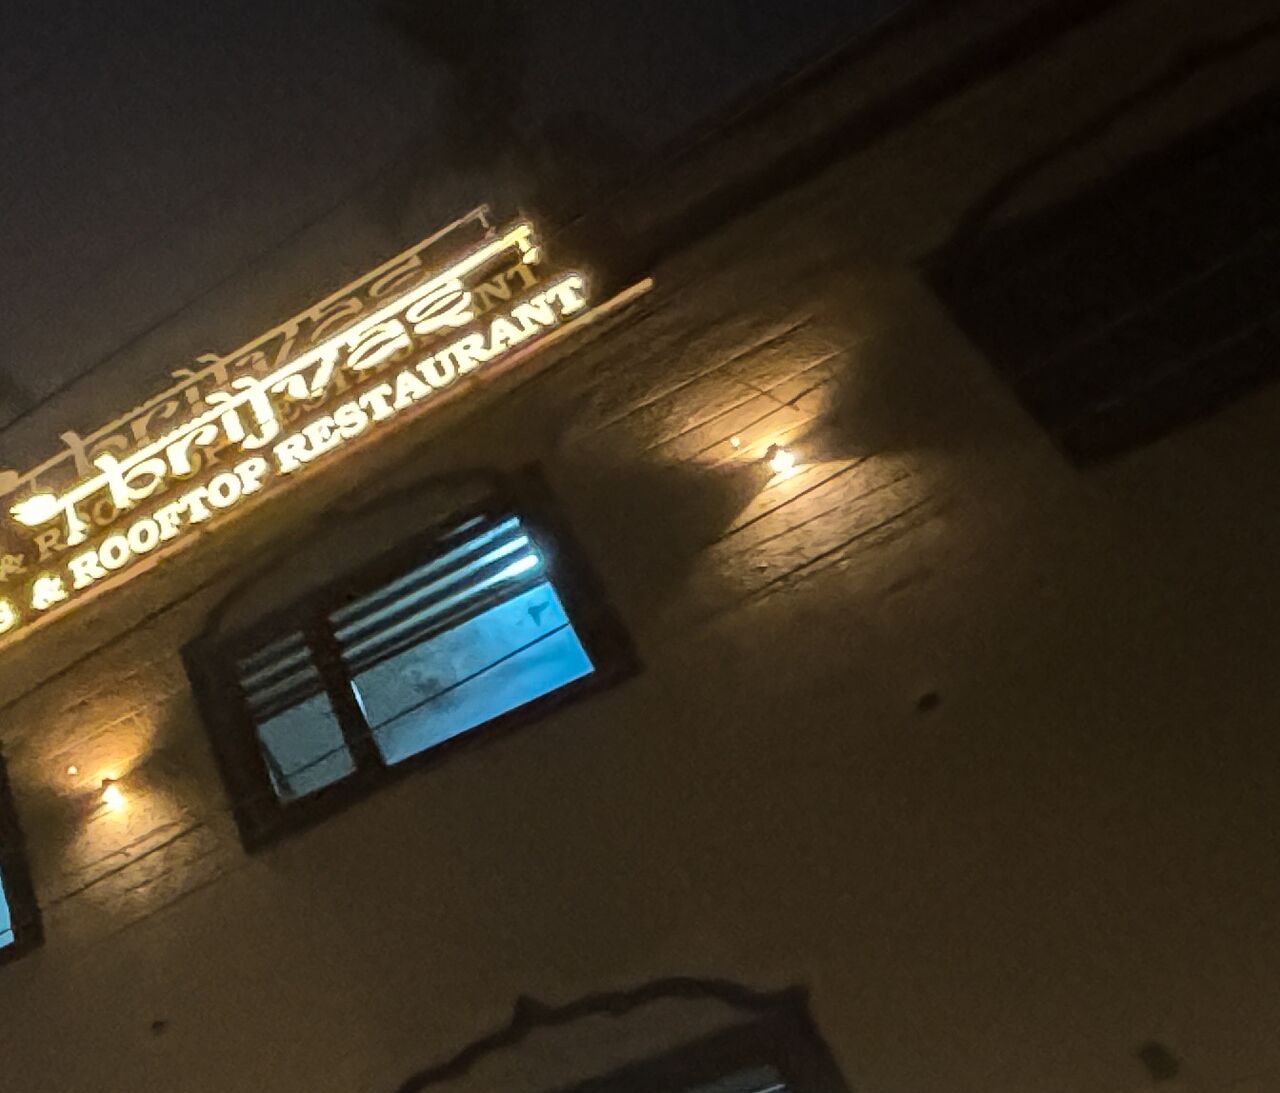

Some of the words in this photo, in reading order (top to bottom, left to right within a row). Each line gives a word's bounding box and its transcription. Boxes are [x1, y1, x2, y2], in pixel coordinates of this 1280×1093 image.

[31, 575, 68, 610] &
[68, 457, 268, 589] ROOFTOP
[273, 275, 587, 475] RESTAURANT
